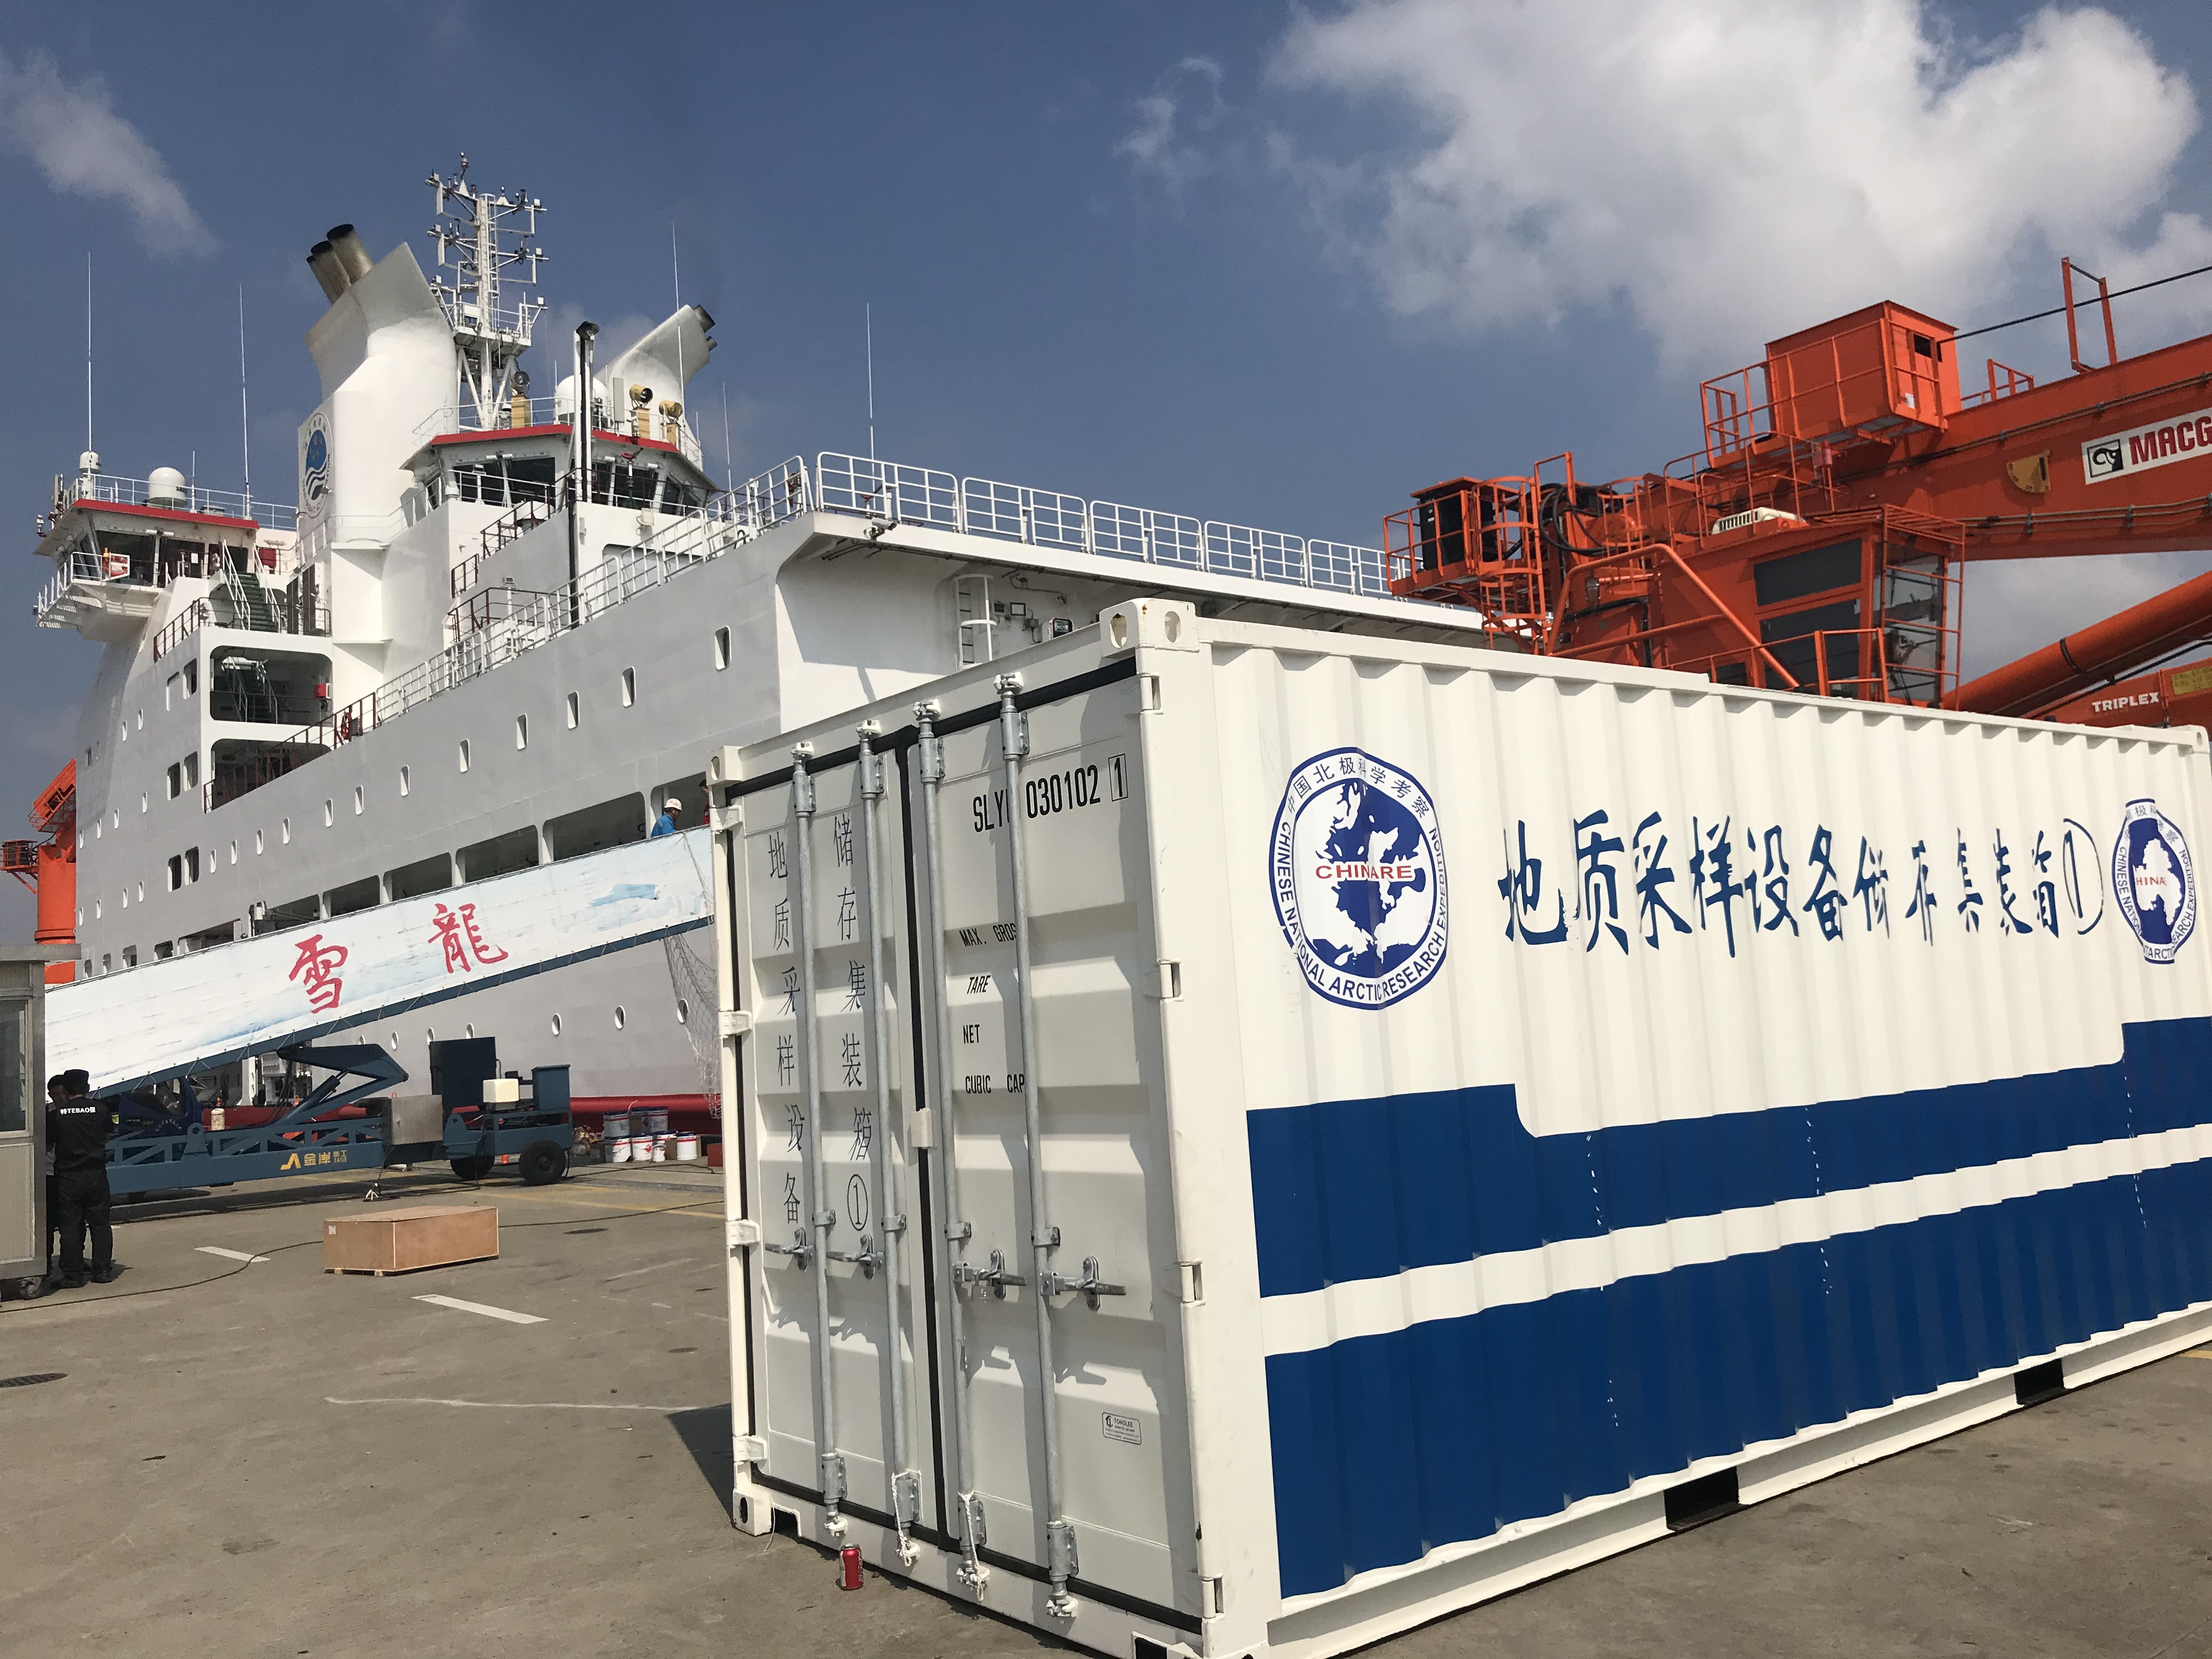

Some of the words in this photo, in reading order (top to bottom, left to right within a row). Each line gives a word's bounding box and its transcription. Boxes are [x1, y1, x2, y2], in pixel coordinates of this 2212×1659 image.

[2091, 691, 2160, 713] TRIPLEX
[973, 788, 1010, 833] SLY
[1025, 764, 1101, 819] 030102
[1288, 757, 1430, 819] 中国北极科学考察
[1277, 821, 1294, 903] CHINESE
[1316, 865, 1413, 879] CHINARE
[1429, 826, 1447, 932] EXPEDITION
[2117, 846, 2129, 894] CHINESE
[2178, 849, 2195, 912] EXPEDITION
[959, 928, 987, 947] MAX.
[1284, 906, 1325, 988] NATIONAL
[1382, 930, 1445, 998] RESEARCH
[967, 975, 991, 994] TARE
[1328, 976, 1383, 1001] ARCTIC
[768, 831, 805, 1224] 地质采样设备
[963, 1024, 980, 1044] NET
[965, 1074, 992, 1094] CUBIC
